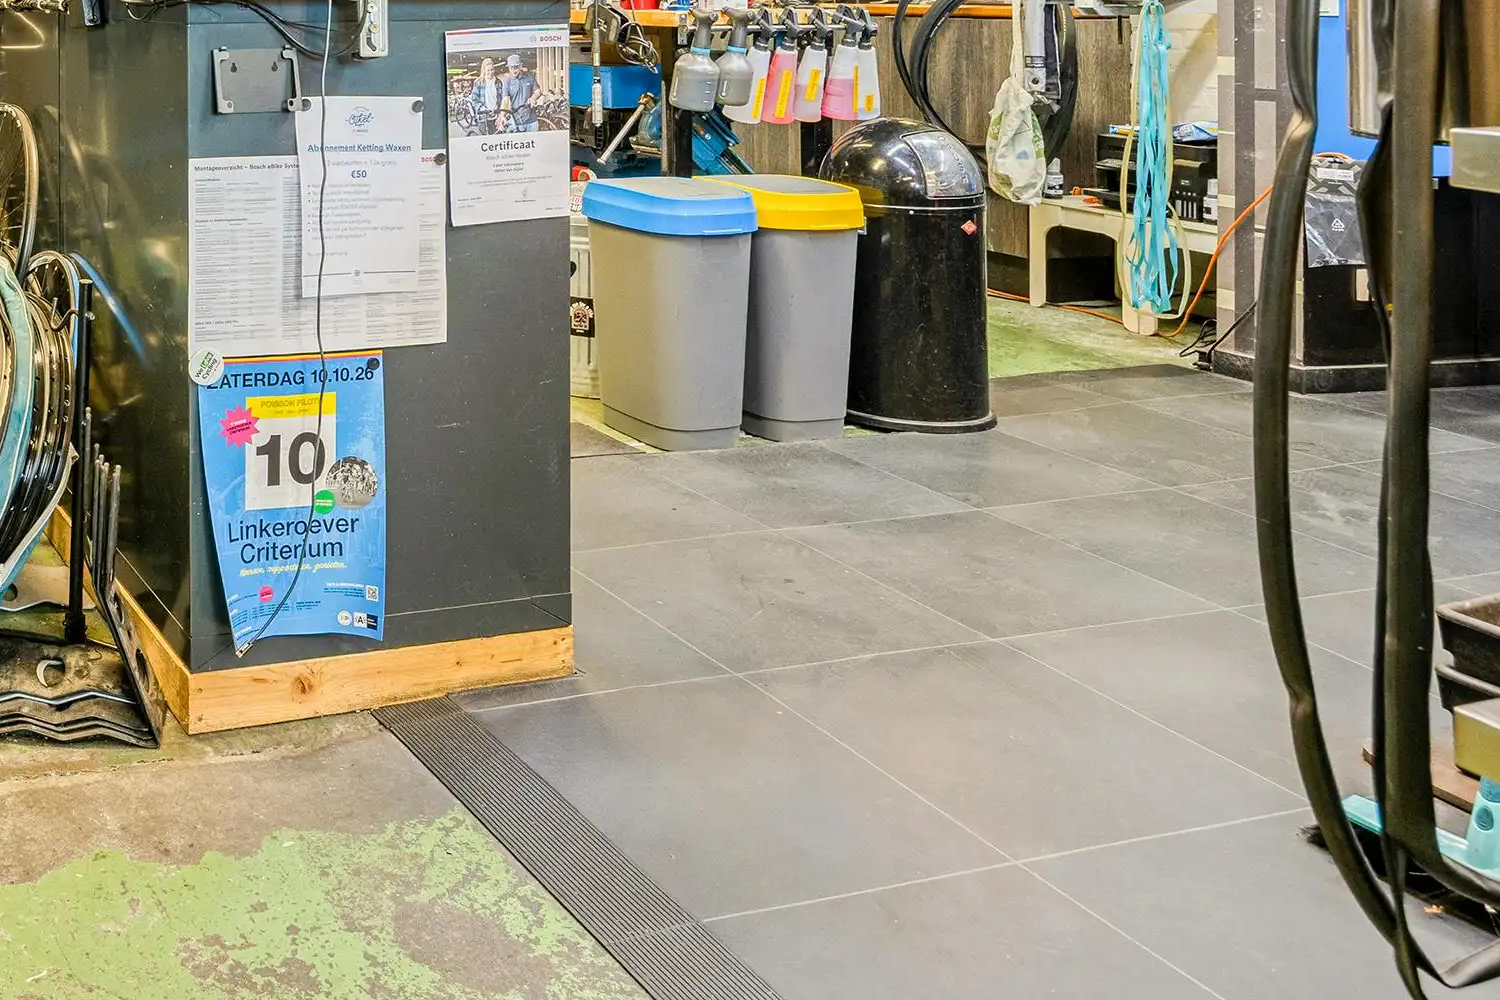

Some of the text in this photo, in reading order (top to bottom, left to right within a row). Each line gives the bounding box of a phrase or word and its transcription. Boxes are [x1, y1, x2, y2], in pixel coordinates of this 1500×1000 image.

[308, 143, 412, 153] Abnnement Ketting Waxen
[481, 139, 535, 151] Certificaat
[194, 164, 243, 172] Montageoverzicht
[350, 169, 368, 178] €50
[311, 367, 374, 384] 10.10.26
[296, 397, 321, 407] PILOT
[256, 431, 326, 486] 10
[228, 516, 360, 543] Linkeroever
[241, 540, 343, 565] Criterium
